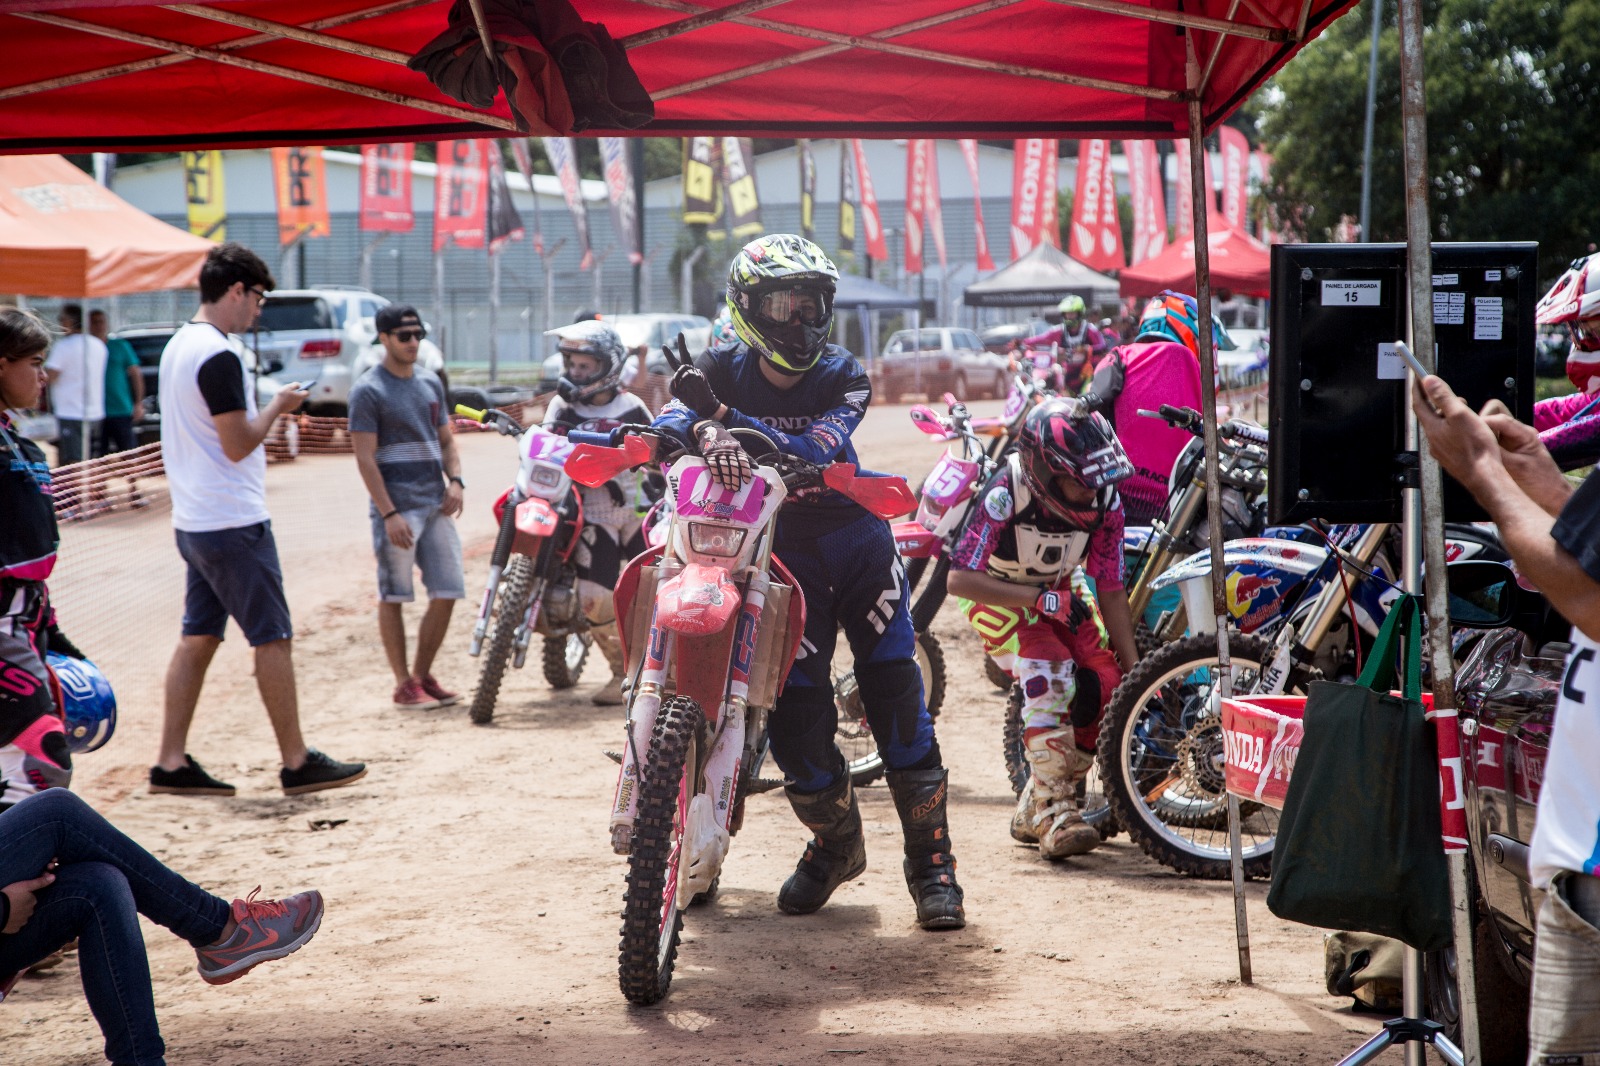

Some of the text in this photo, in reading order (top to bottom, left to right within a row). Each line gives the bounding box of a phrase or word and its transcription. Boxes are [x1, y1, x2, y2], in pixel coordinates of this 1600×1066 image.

[187, 150, 208, 204] PR
[288, 147, 312, 206] PR
[1018, 139, 1043, 226] HOND
[1082, 139, 1105, 225] HOND
[1344, 292, 1358, 303] 15
[672, 617, 705, 627] HONDA
